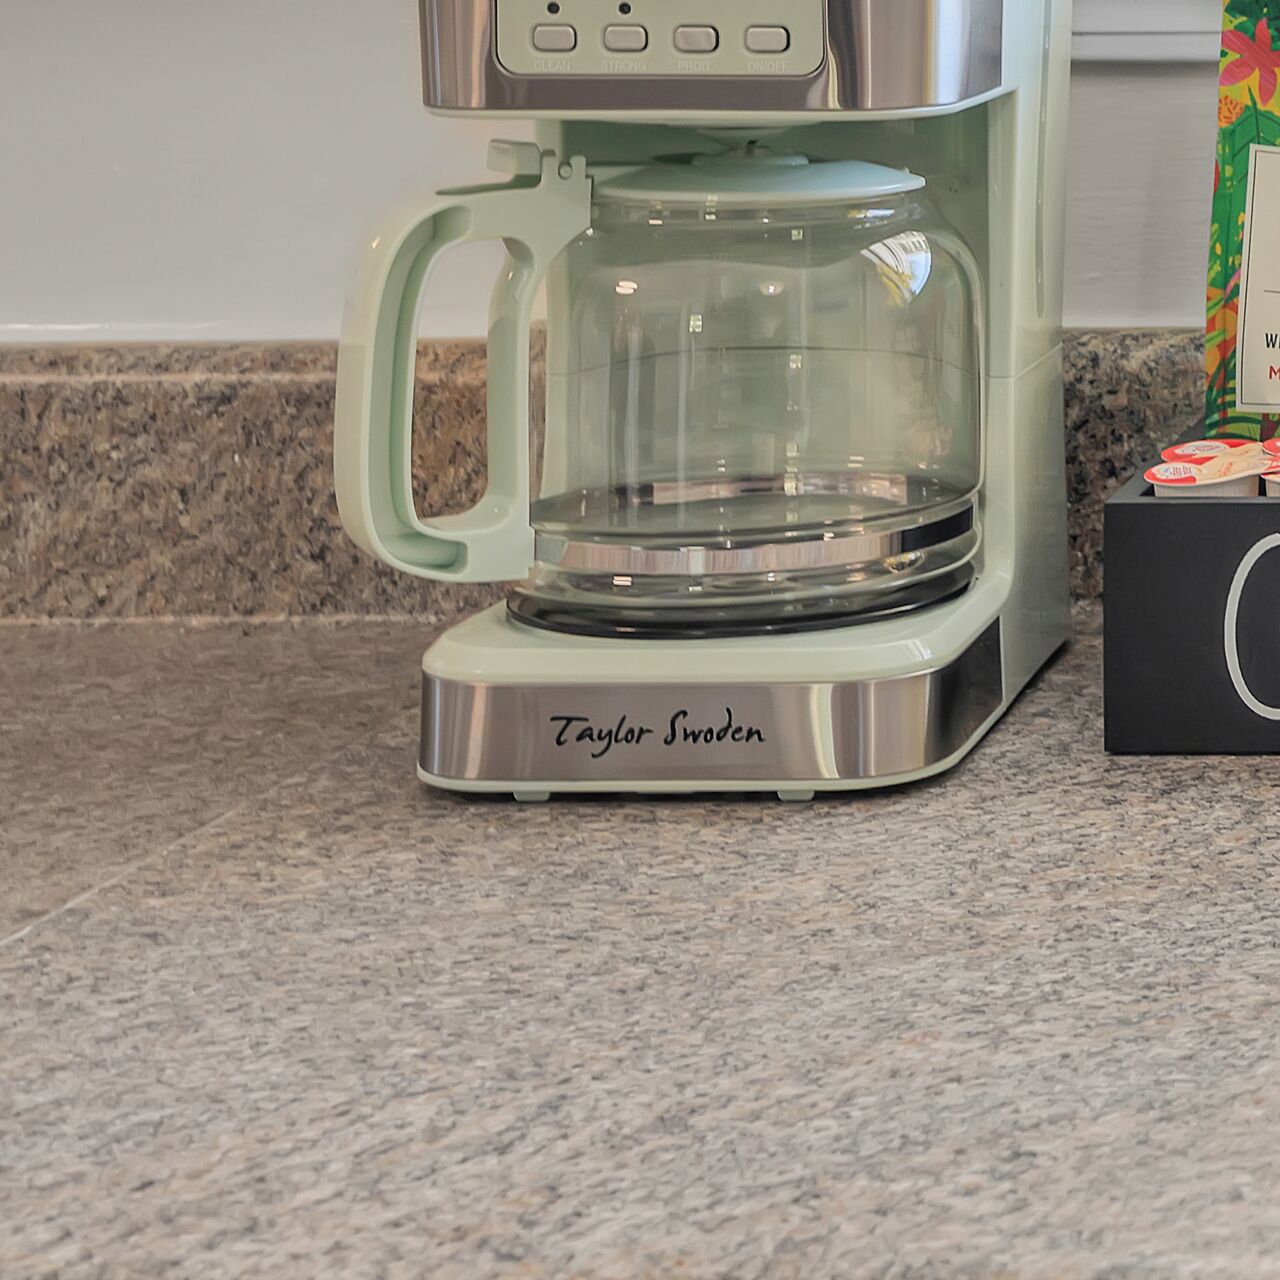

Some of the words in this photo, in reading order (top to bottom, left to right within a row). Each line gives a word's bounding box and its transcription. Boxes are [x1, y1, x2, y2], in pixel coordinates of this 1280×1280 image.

[534, 60, 571, 71] CLEAN
[601, 60, 647, 71] STRONG
[678, 60, 710, 71] PROG
[747, 60, 787, 71] ON/OFF
[550, 714, 654, 759] Taylor
[663, 707, 767, 746] Swoden
